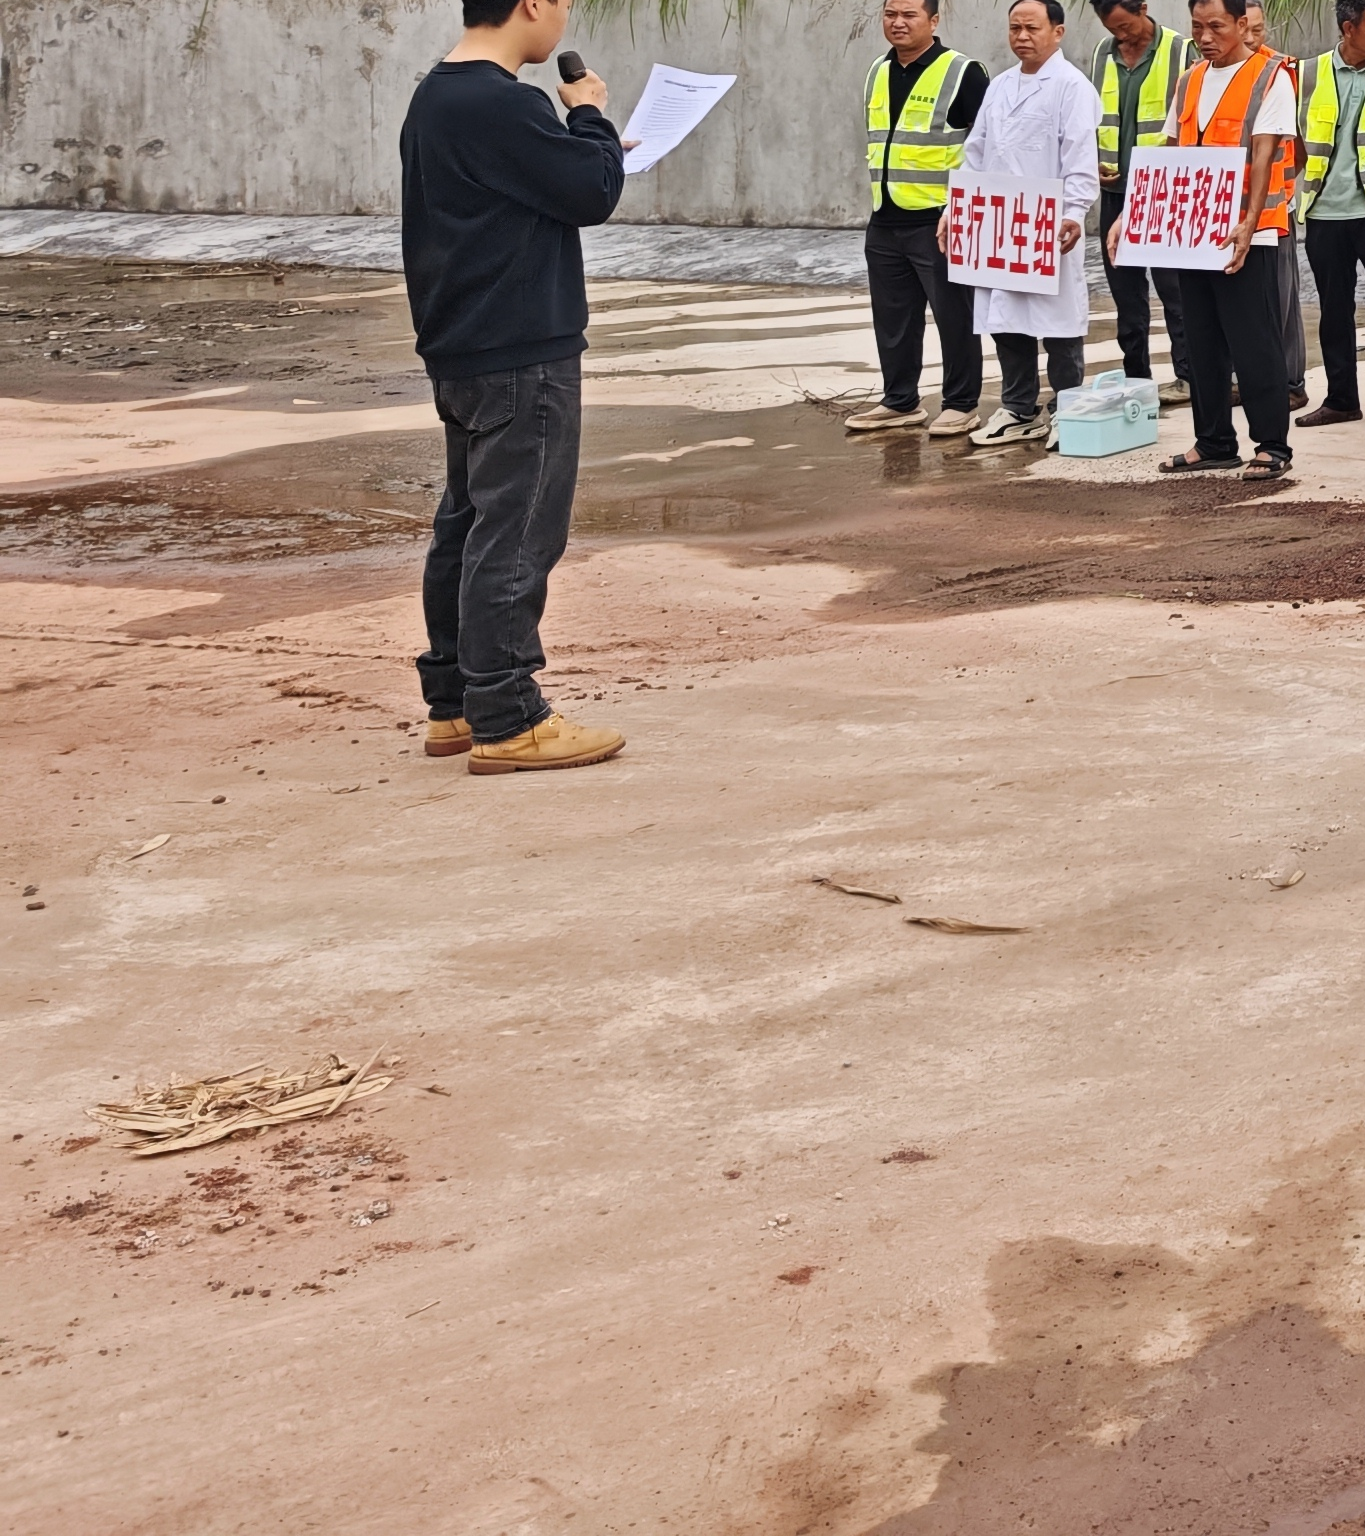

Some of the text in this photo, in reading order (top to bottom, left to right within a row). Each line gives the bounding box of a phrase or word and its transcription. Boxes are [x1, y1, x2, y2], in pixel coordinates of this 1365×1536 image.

[950, 187, 1056, 277] 医疗卫生组
[1126, 165, 1236, 249] 避险转移组
